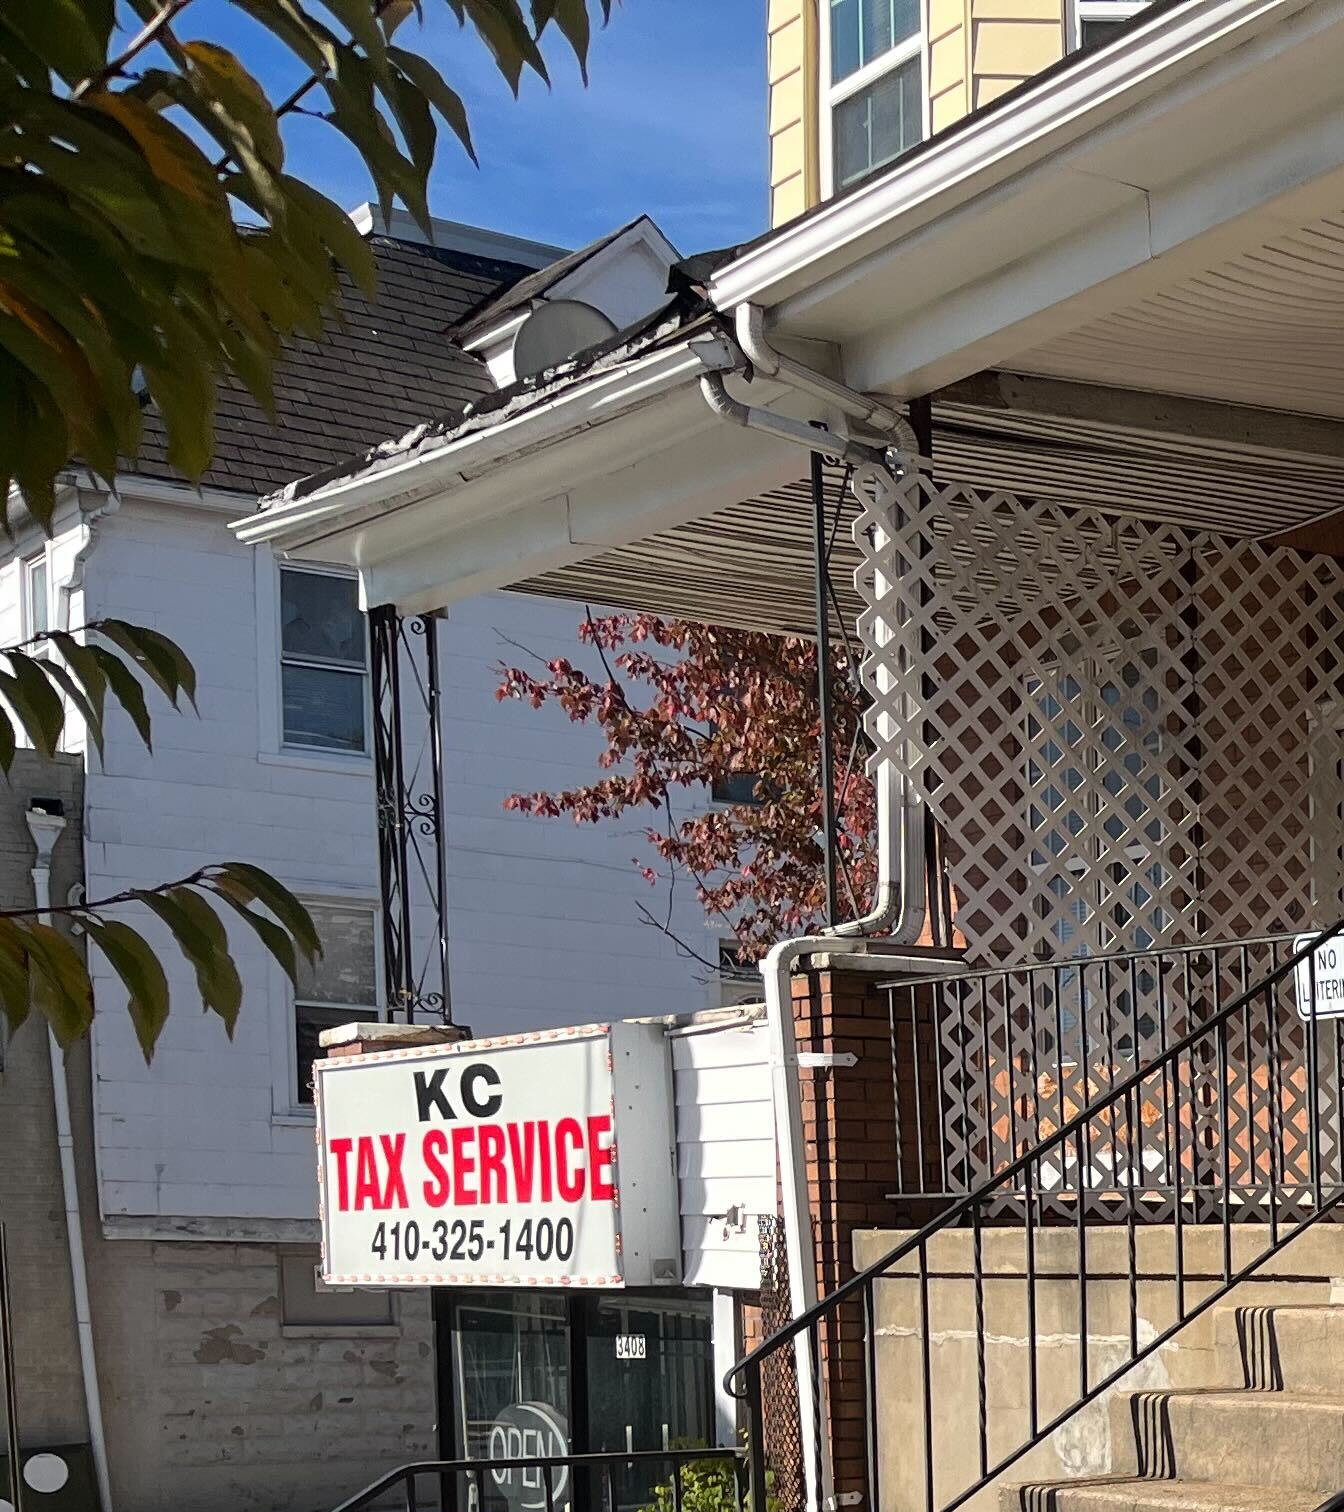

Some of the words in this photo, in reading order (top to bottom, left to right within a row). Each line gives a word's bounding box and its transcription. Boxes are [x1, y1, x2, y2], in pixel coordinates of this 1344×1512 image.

[1318, 949, 1337, 970] NO
[413, 1063, 503, 1123] KC
[330, 1132, 409, 1213] TAX
[422, 1115, 619, 1208] SERVICE
[371, 1217, 574, 1262] 410-325-1400
[617, 1335, 646, 1357] 3408
[489, 1425, 553, 1489] OPEN
